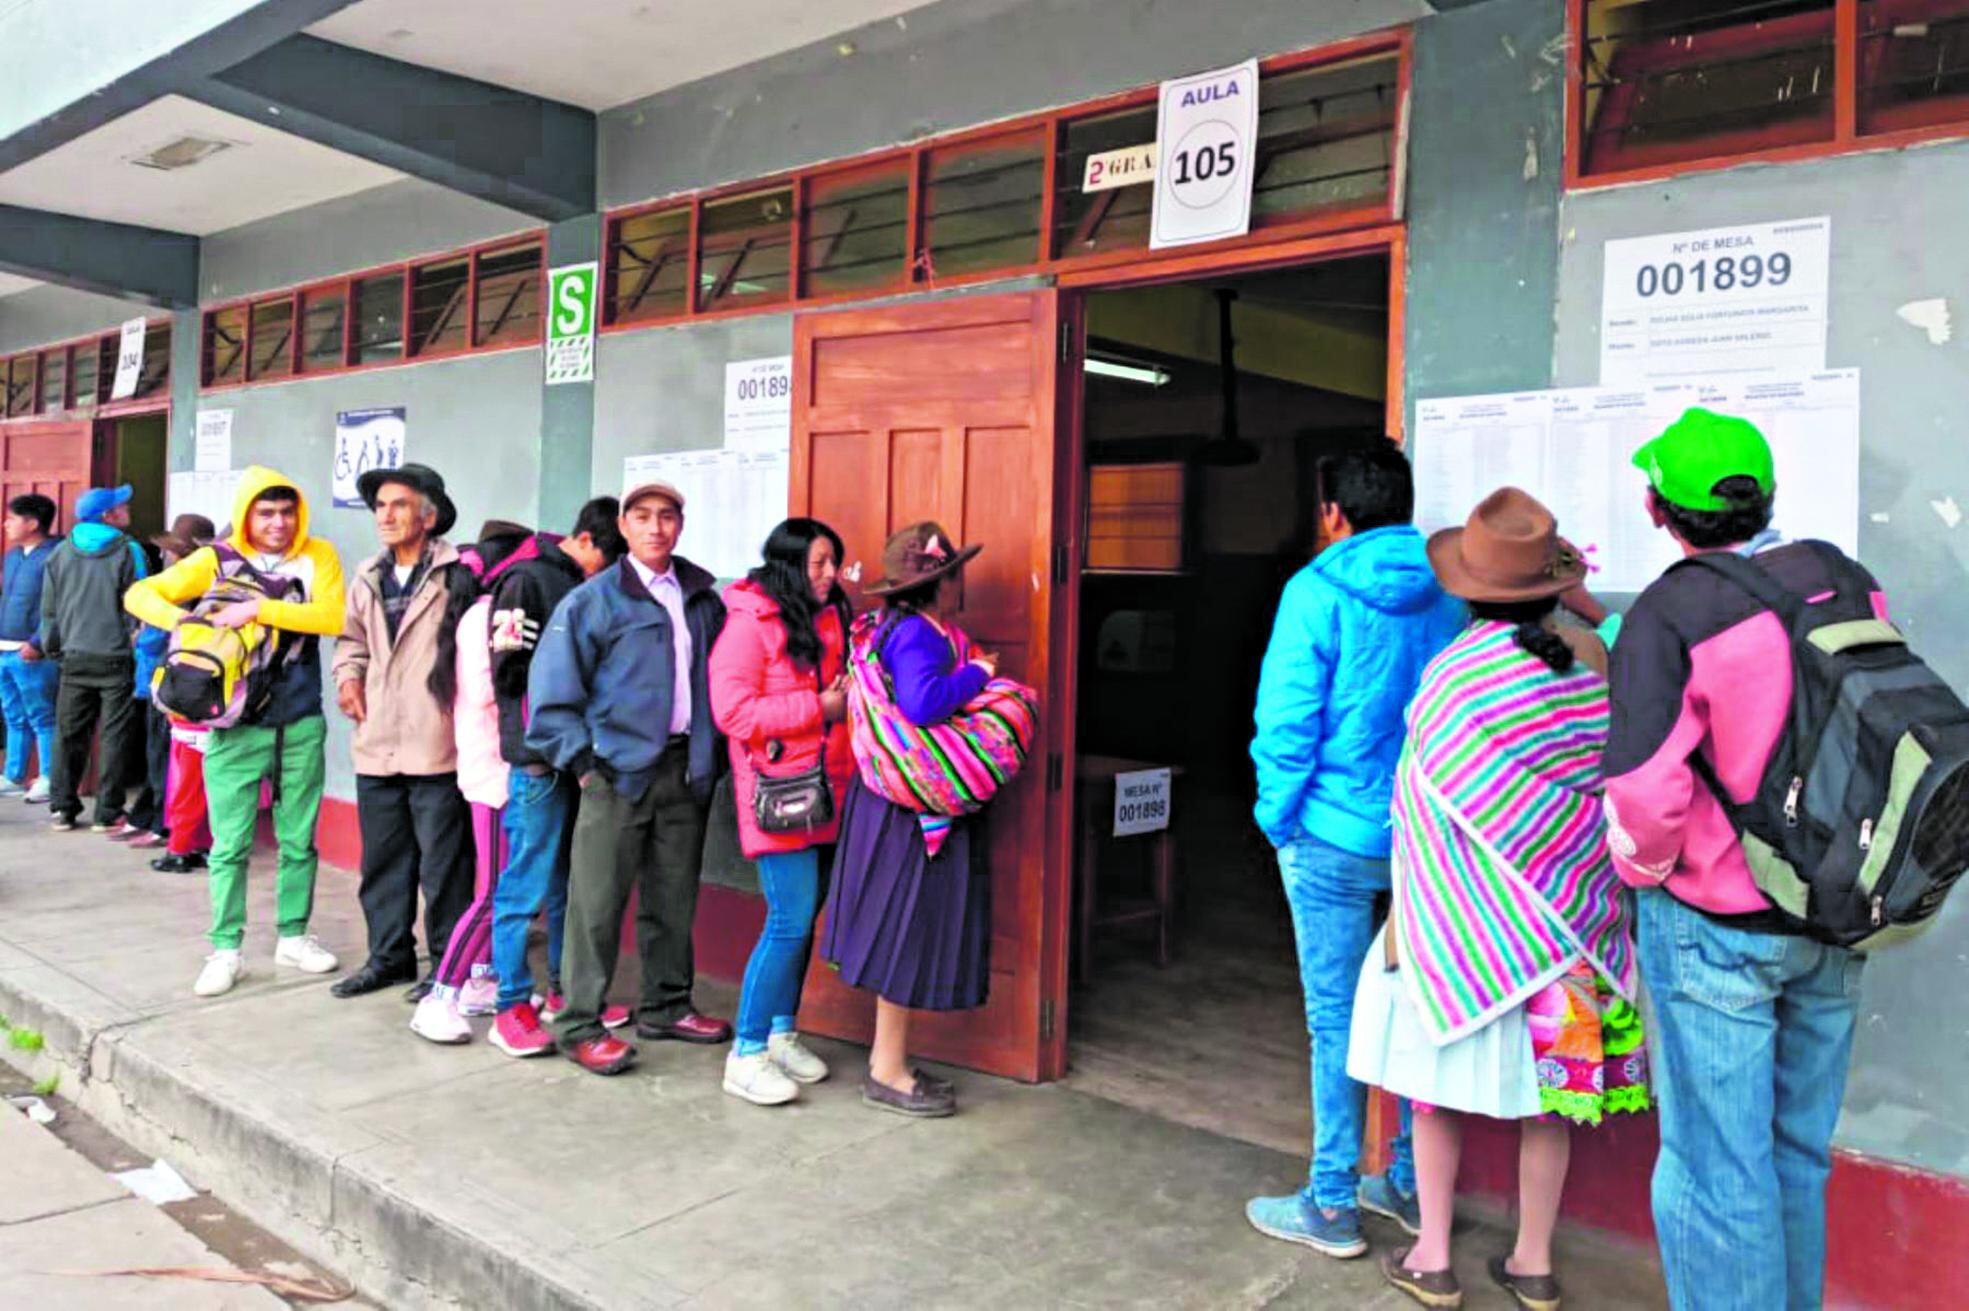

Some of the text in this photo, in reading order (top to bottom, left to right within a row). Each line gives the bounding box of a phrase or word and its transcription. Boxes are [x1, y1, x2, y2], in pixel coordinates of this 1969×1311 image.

[1181, 80, 1240, 107] AULA
[1174, 141, 1236, 186] 105
[1691, 240, 1712, 252] DE
[1714, 235, 1754, 249] MESA
[1636, 252, 1792, 298] 001899
[557, 275, 585, 335] S
[737, 375, 792, 400] 00189
